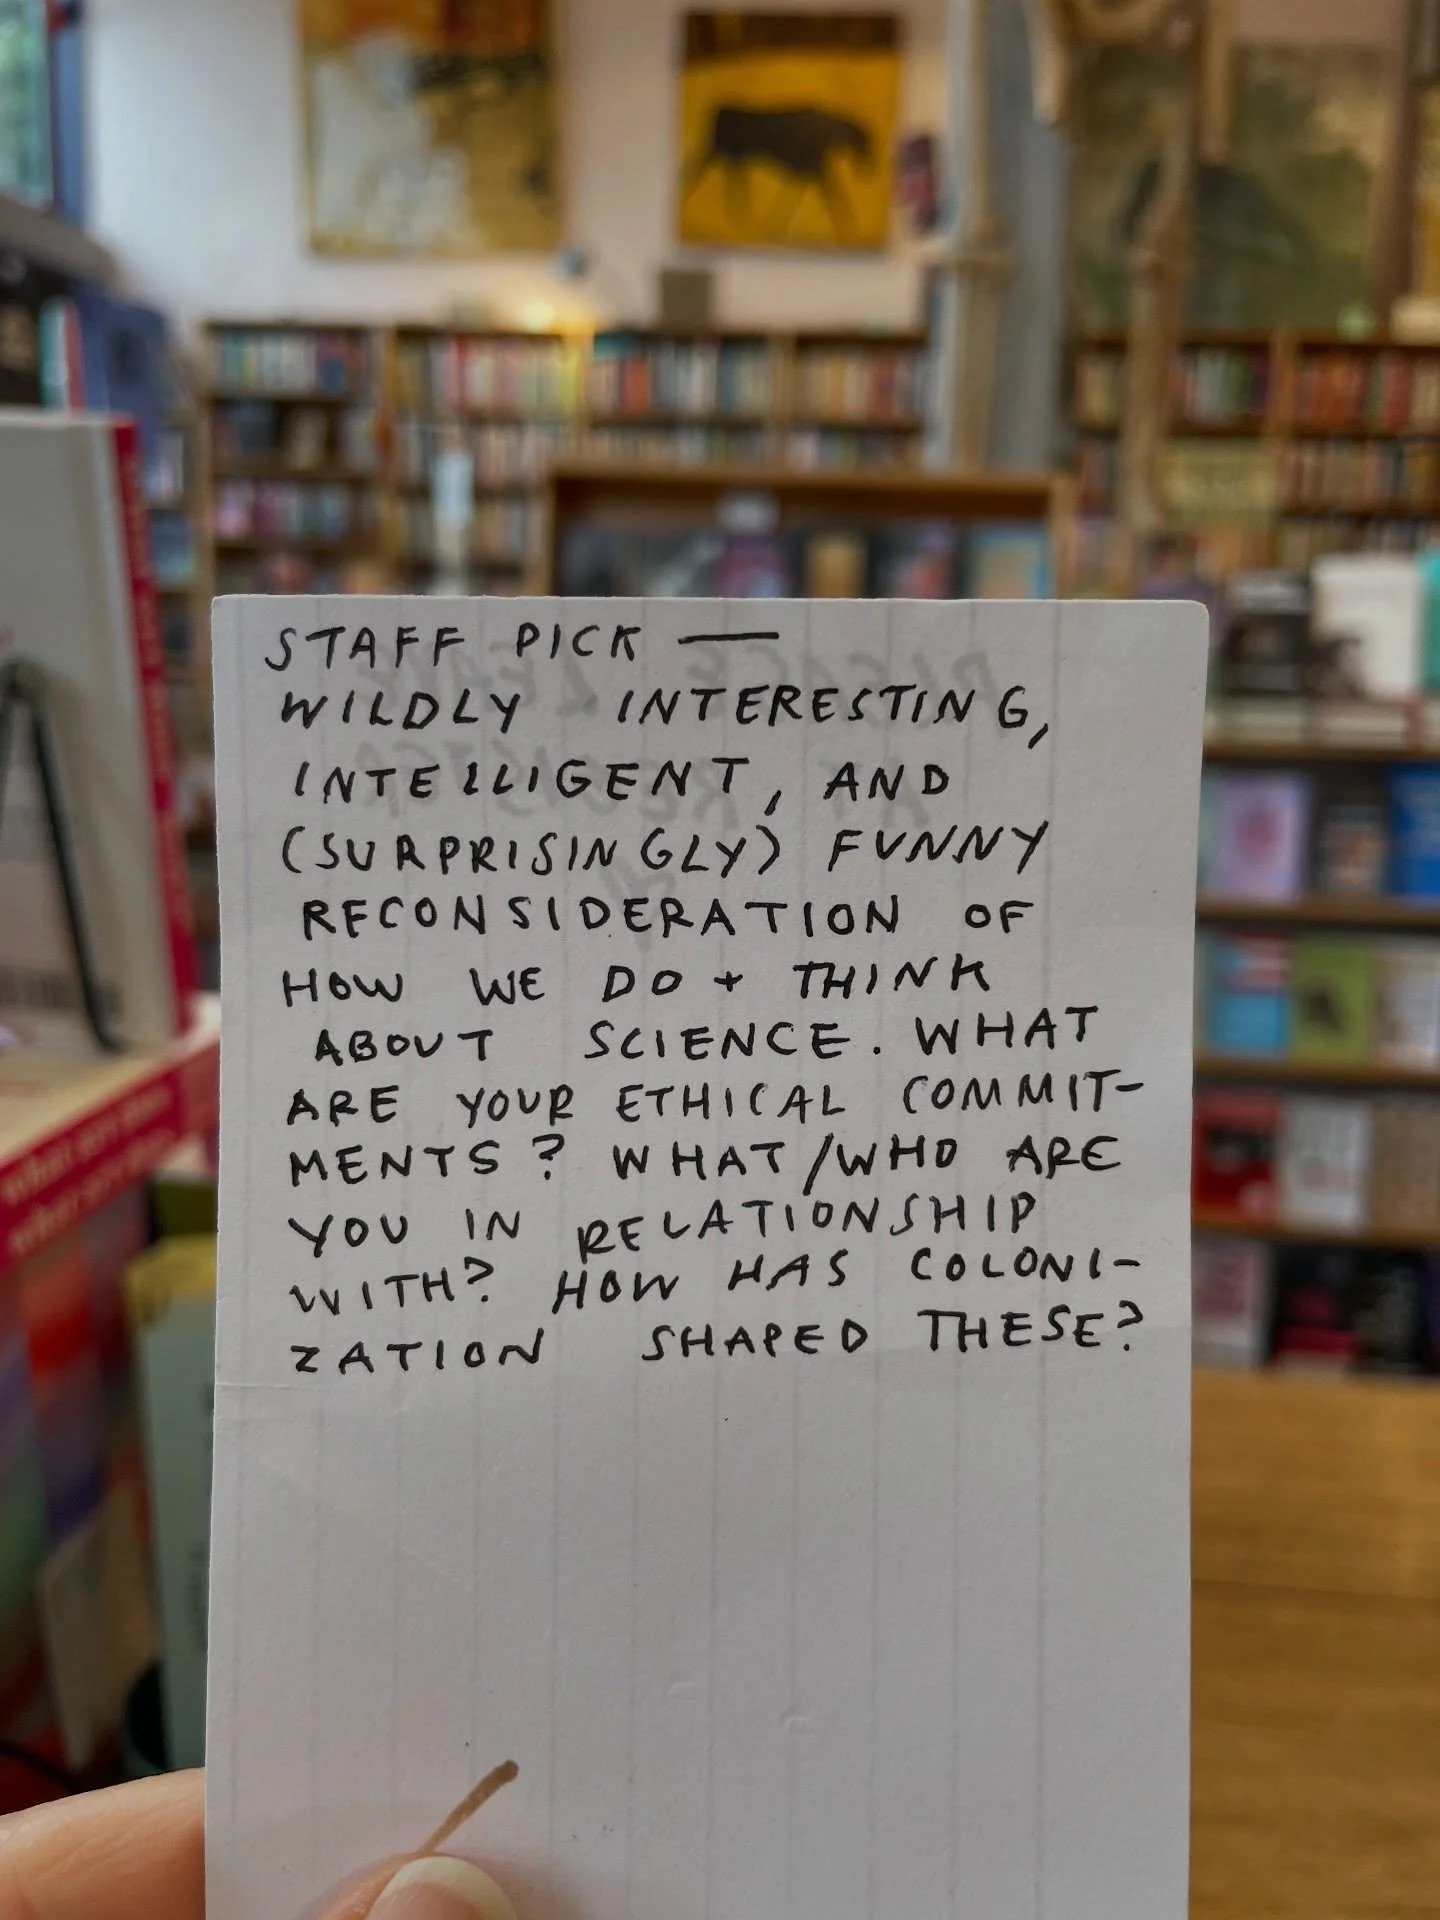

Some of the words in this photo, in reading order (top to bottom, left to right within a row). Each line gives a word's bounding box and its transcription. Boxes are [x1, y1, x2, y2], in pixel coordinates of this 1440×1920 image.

[263, 625, 466, 673] STAFF
[515, 621, 643, 663] PICK
[280, 687, 522, 735] WILDLY
[616, 682, 1050, 751] INTERESTING,
[293, 756, 783, 818] INTELLIGENT,
[821, 760, 951, 803] AND
[280, 823, 782, 880] (SURPRISINGLY)
[826, 819, 1050, 876] FUNNY
[963, 899, 1035, 935] OF
[281, 966, 404, 1009] HOW
[467, 965, 546, 1007] WE
[600, 964, 684, 1004] DO
[791, 951, 991, 1001] THINK
[313, 1027, 495, 1068] ABOUT
[583, 1018, 882, 1062] SCIENCE.
[914, 1004, 1100, 1057] WHAT
[285, 1083, 400, 1129] ARE
[454, 1082, 575, 1130] YOUR
[614, 1081, 847, 1125] ETHICAL
[901, 1067, 1145, 1115] COMMIT-
[288, 1132, 566, 1189] MENTS?
[611, 1131, 959, 1198] WHAT/WHO
[1005, 1133, 1122, 1181] ARE
[286, 1213, 409, 1260] YOU
[464, 1207, 521, 1242] IN
[576, 1190, 1037, 1266] RELATIONSHIP
[288, 1266, 490, 1317] WITH?
[550, 1268, 681, 1316] HOW
[726, 1247, 850, 1292] HAS
[909, 1244, 1142, 1284] COLONI-
[289, 1326, 546, 1376] ZATION
[640, 1317, 869, 1362] SHAPED
[915, 1298, 1145, 1354] THESE?
